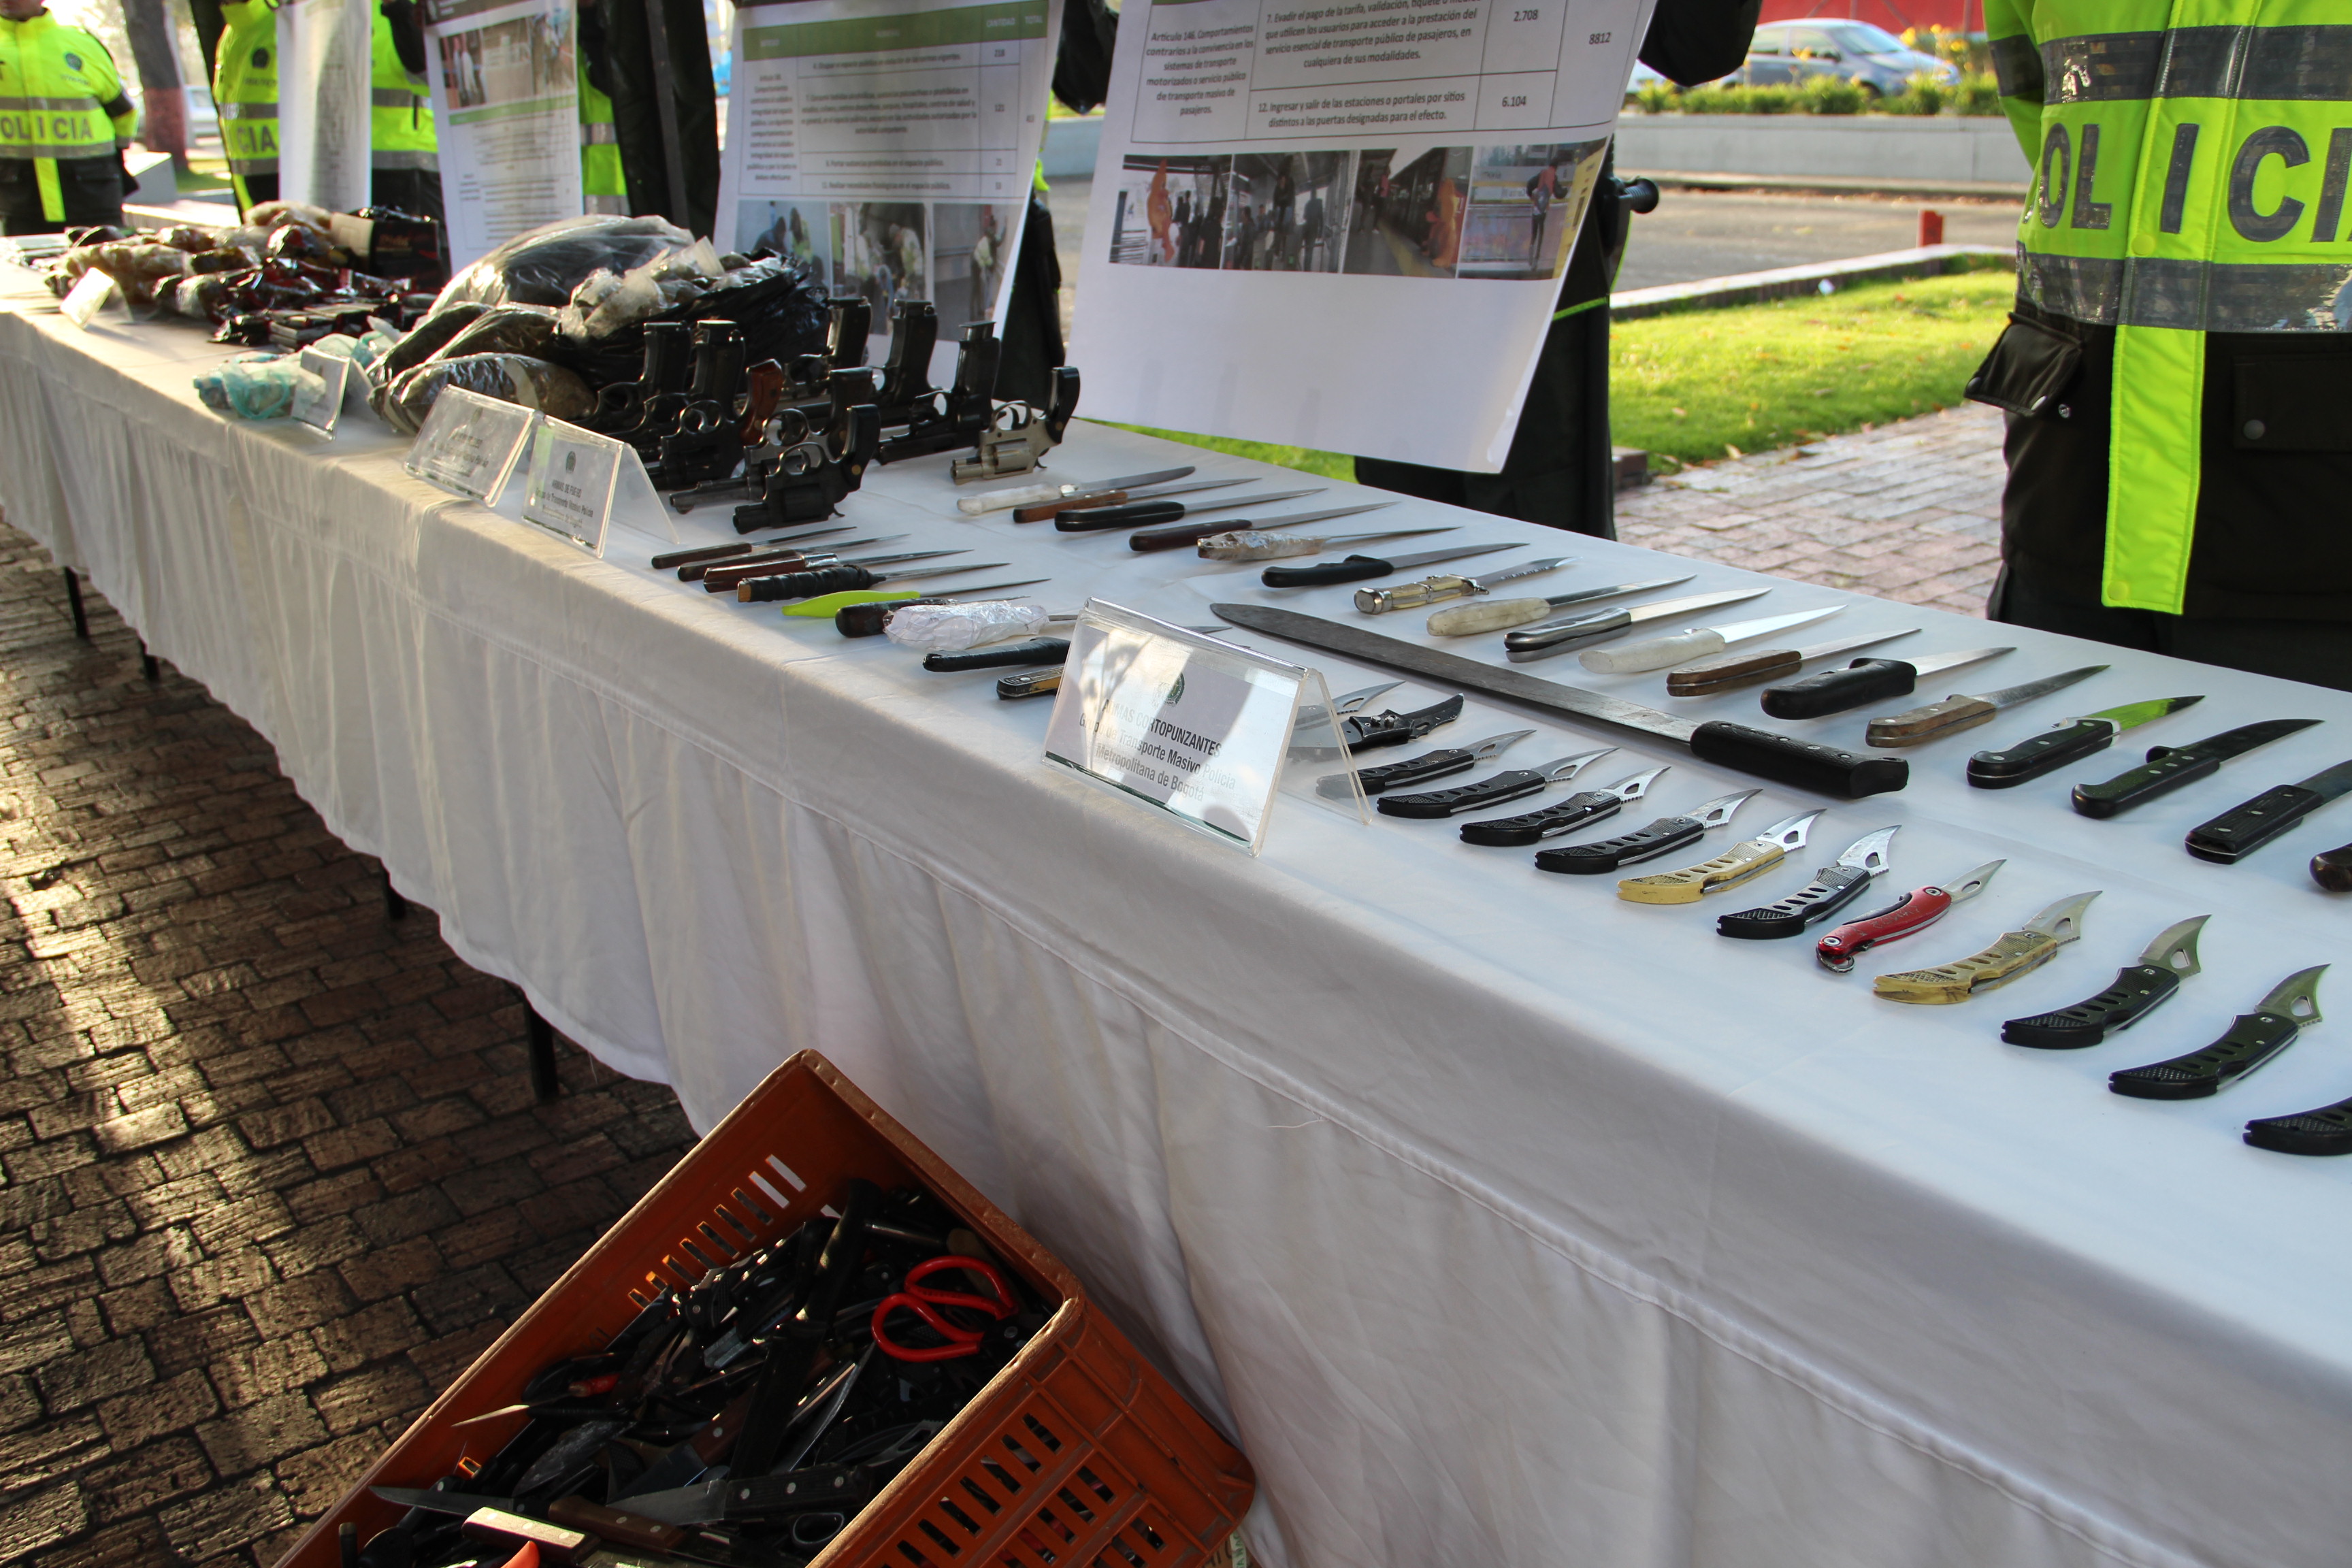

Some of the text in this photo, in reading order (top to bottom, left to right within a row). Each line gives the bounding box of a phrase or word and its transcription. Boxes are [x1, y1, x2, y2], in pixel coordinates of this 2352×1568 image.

[1274, 12, 1296, 22] Evadir
[1297, 10, 1304, 20] el
[1305, 10, 1324, 21] pago
[1324, 7, 1335, 17] de
[1337, 7, 1342, 16] la
[1344, 4, 1365, 14] tarifa,
[1514, 10, 1539, 22] 2.708
[1265, 31, 1278, 41] que
[1279, 27, 1305, 37] utilicen
[1307, 26, 1316, 35] los
[1318, 22, 1349, 33] usuarios
[1350, 20, 1367, 31] para
[1369, 16, 1399, 29] acceder
[1409, 15, 1415, 24] la
[1417, 10, 1460, 25] prestación
[1463, 8, 1477, 19] del
[1265, 29, 1471, 54] servicio esencial de transporte público de pasajeros, en
[1588, 32, 1611, 44] 8812
[1304, 49, 1420, 68] cualquiera de sus modalidades.
[1258, 103, 1267, 112] 12.
[1270, 102, 1298, 114] Ingresar
[1305, 99, 1320, 109] salir
[1321, 98, 1330, 108] de
[1332, 98, 1341, 108] las
[1344, 95, 1384, 106] estaciones
[1392, 93, 1425, 106] portales
[1426, 94, 1441, 104] por
[1443, 91, 1465, 102] sitios
[1501, 95, 1526, 107] 6.104
[1269, 117, 1298, 127] distintos
[1305, 116, 1315, 126] las
[1316, 115, 1344, 127] puertas
[1346, 112, 1388, 125] designadas
[1390, 114, 1407, 124] para
[1409, 110, 1416, 120] el
[1418, 109, 1446, 120] efecto.
[1135, 712, 1222, 758] CORTOPUNZANTES
[1119, 728, 1166, 760] Transporte
[1166, 749, 1201, 774] Masivo
[1096, 742, 1205, 802] Metropolitana de Bogotá
